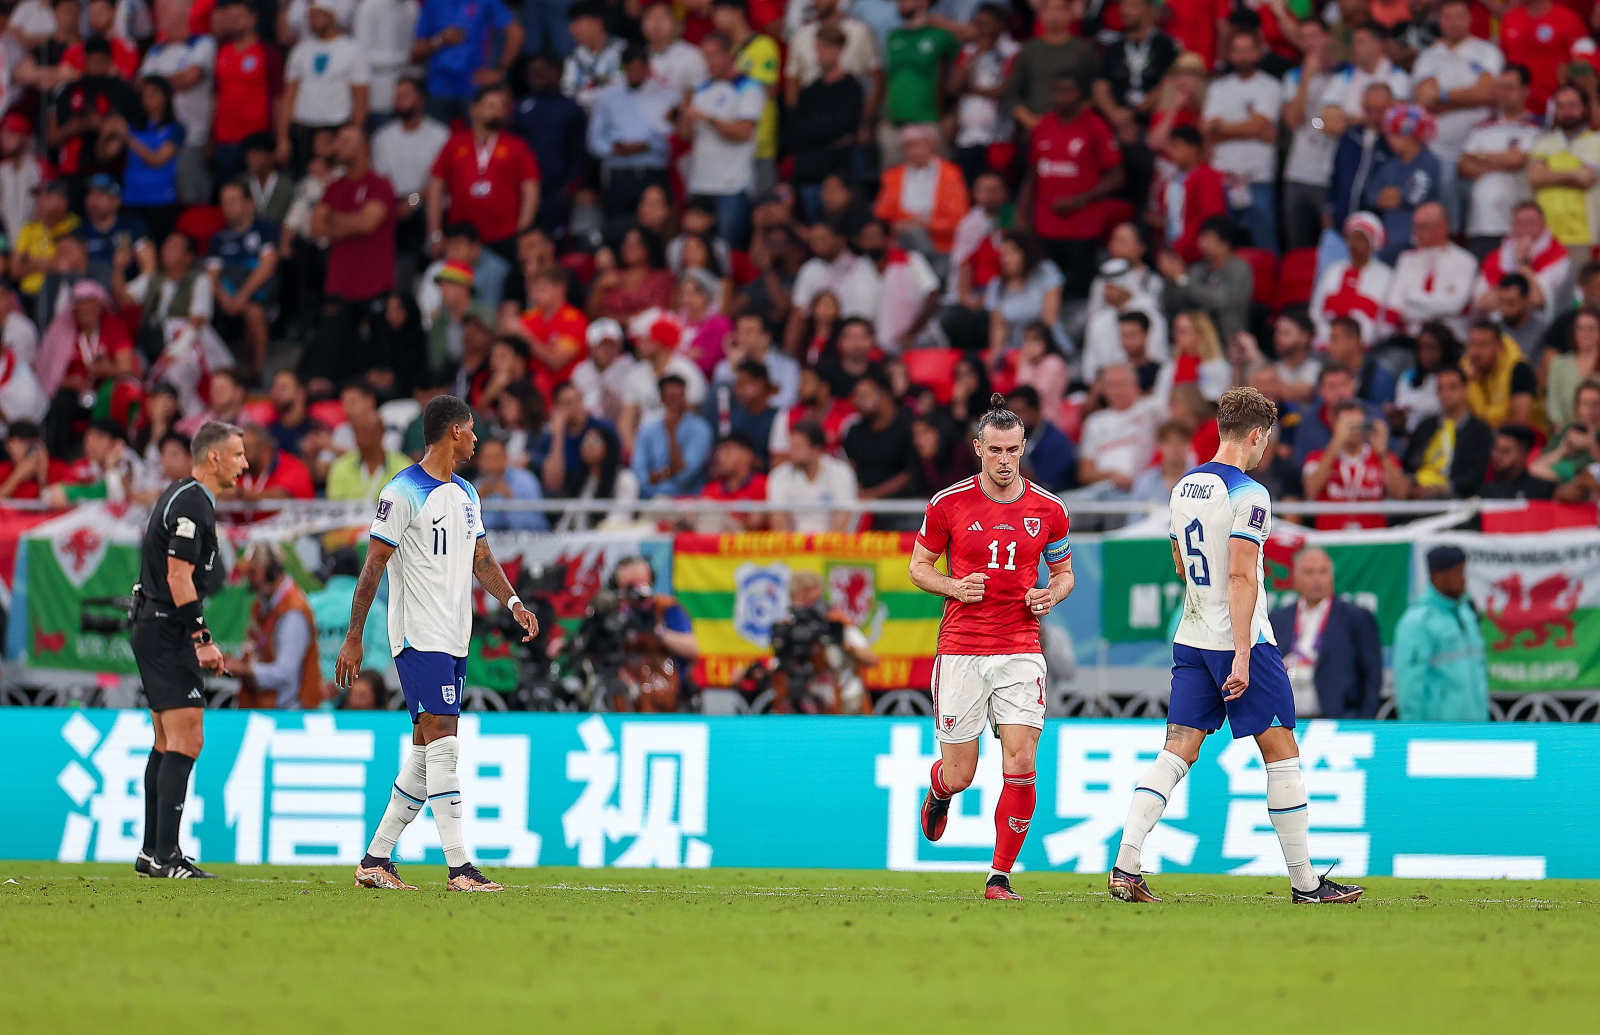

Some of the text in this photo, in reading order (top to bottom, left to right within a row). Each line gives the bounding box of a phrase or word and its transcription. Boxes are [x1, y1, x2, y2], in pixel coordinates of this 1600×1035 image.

[1180, 483, 1215, 499] STONES
[432, 527, 447, 555] 11
[987, 540, 1017, 571] 11
[1184, 517, 1211, 586] 5
